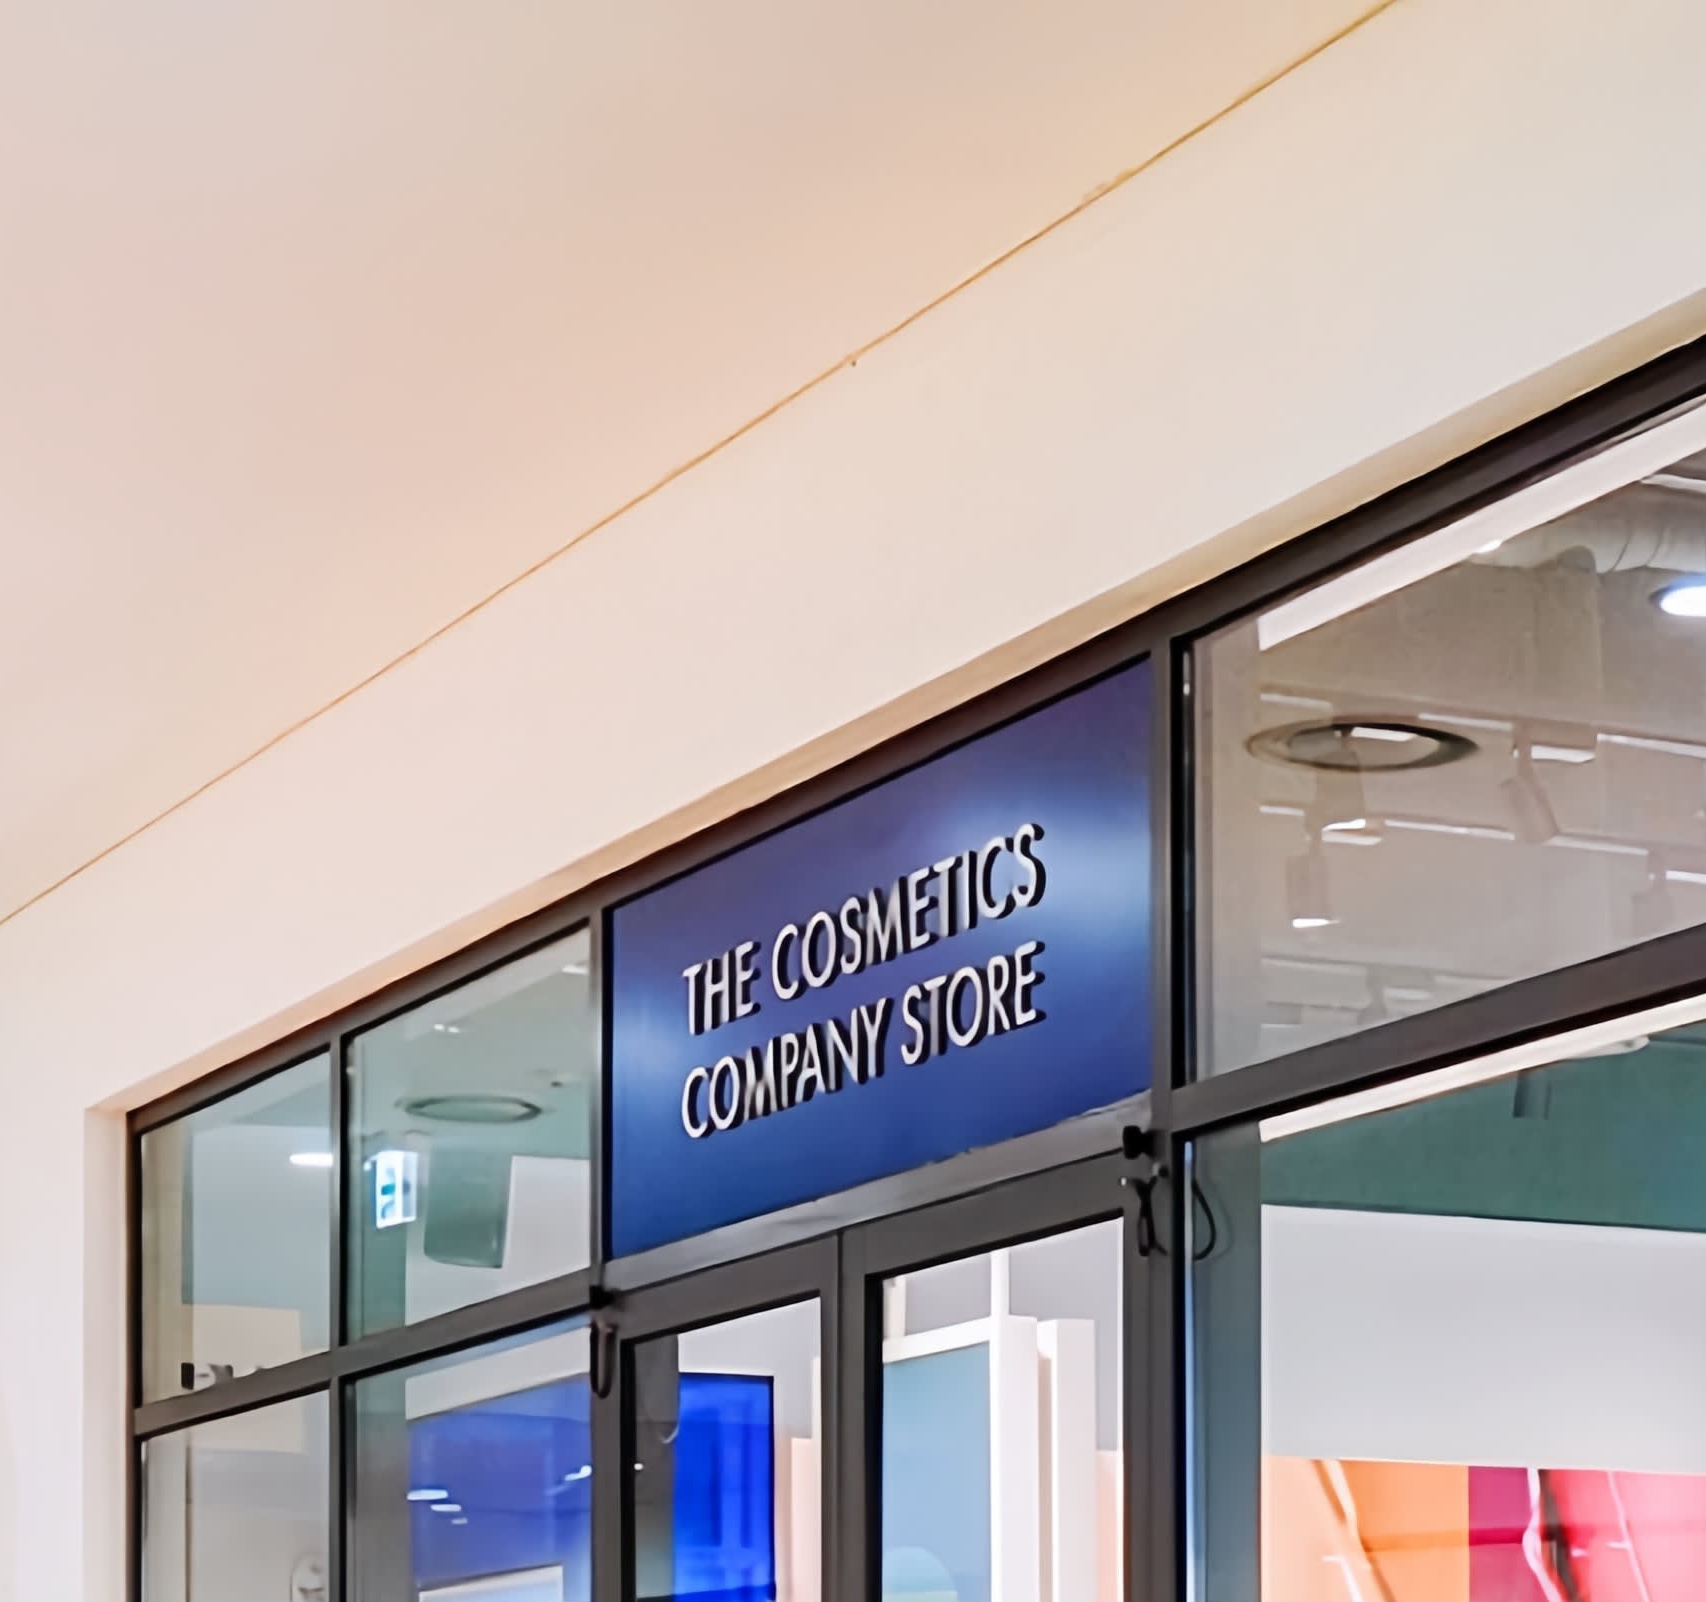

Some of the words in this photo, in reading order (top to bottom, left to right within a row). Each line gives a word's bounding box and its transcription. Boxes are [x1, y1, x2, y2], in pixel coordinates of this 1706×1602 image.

[682, 940, 761, 1036] THE
[771, 822, 1047, 1001] COSMETICS
[681, 998, 893, 1139] COMPANY
[901, 940, 1047, 1067] STORE
